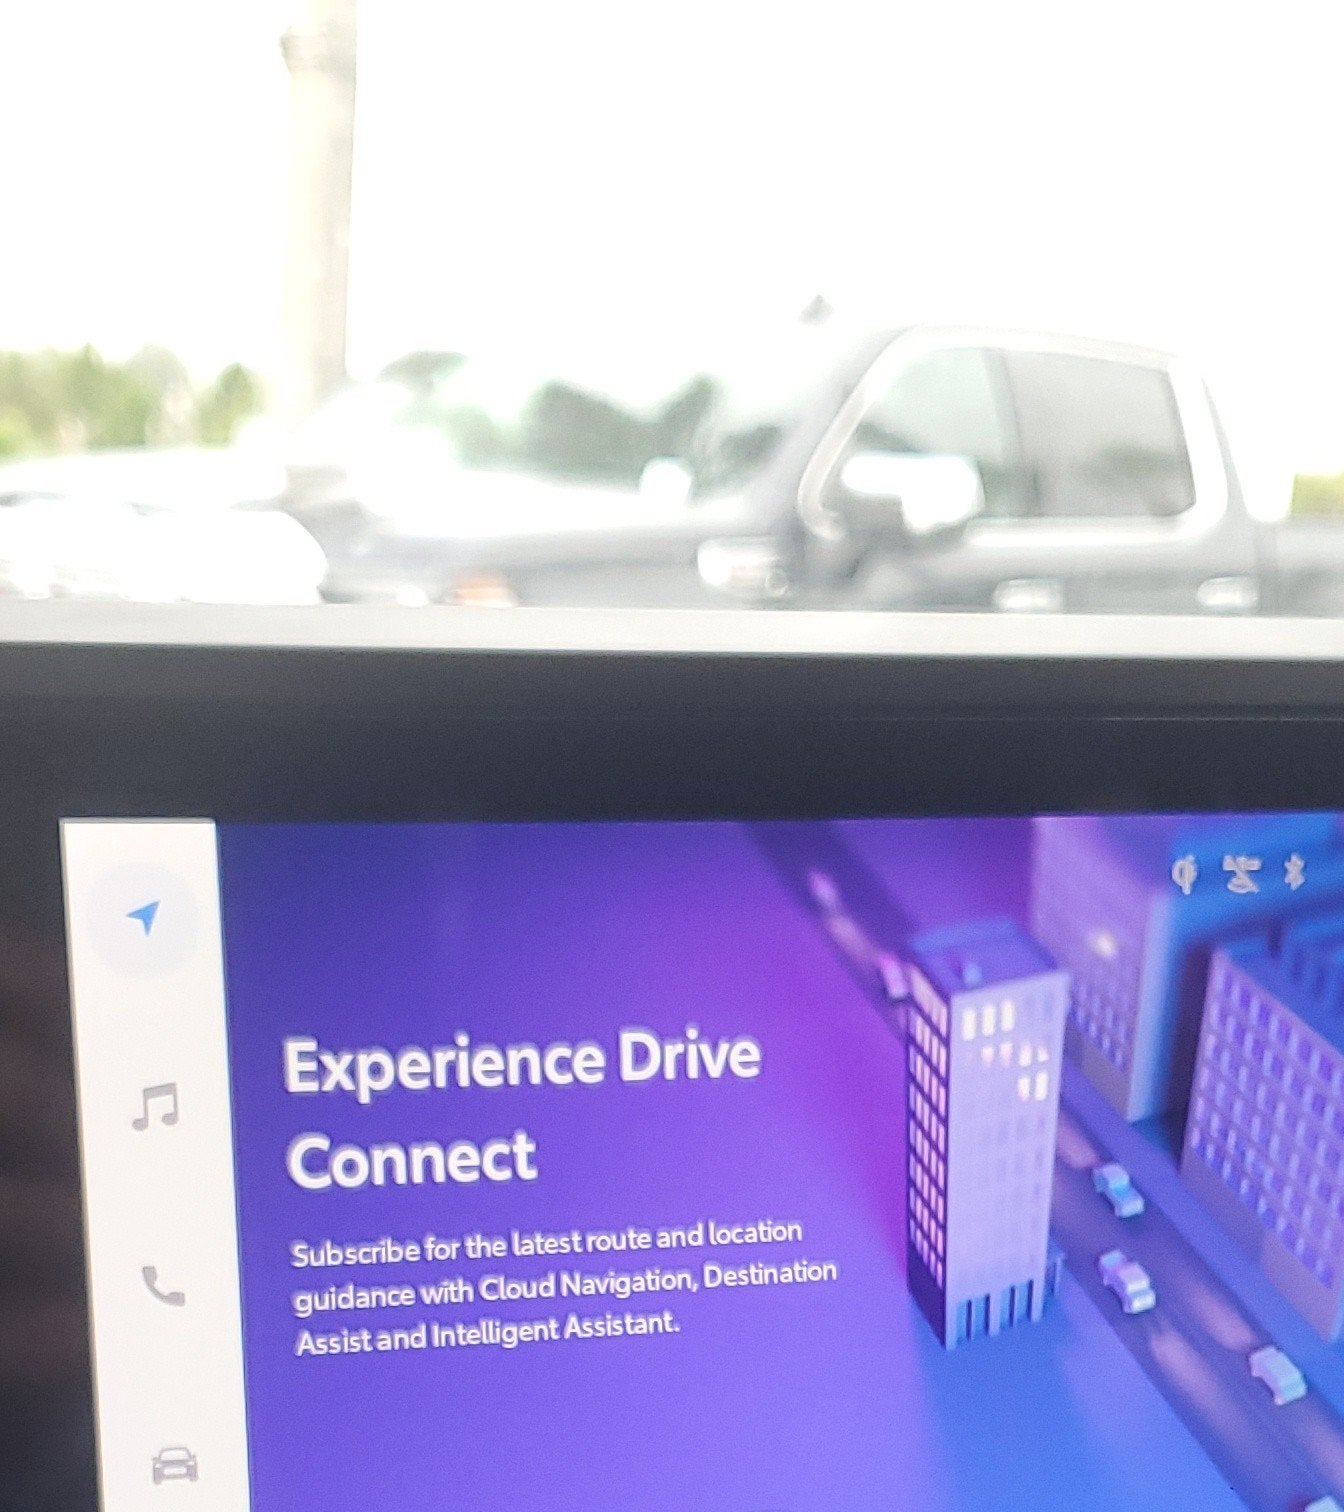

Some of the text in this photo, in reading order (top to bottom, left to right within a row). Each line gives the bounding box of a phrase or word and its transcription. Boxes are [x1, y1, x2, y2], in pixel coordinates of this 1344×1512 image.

[283, 1027, 762, 1105] Experience Drive
[286, 1129, 538, 1190] Connect
[290, 1217, 803, 1268] Subscribe for the latest route and location
[293, 1259, 838, 1318] guidance with Cloud Navigation, Destination
[294, 1309, 680, 1357] Assist and Intelligent Assistant.
